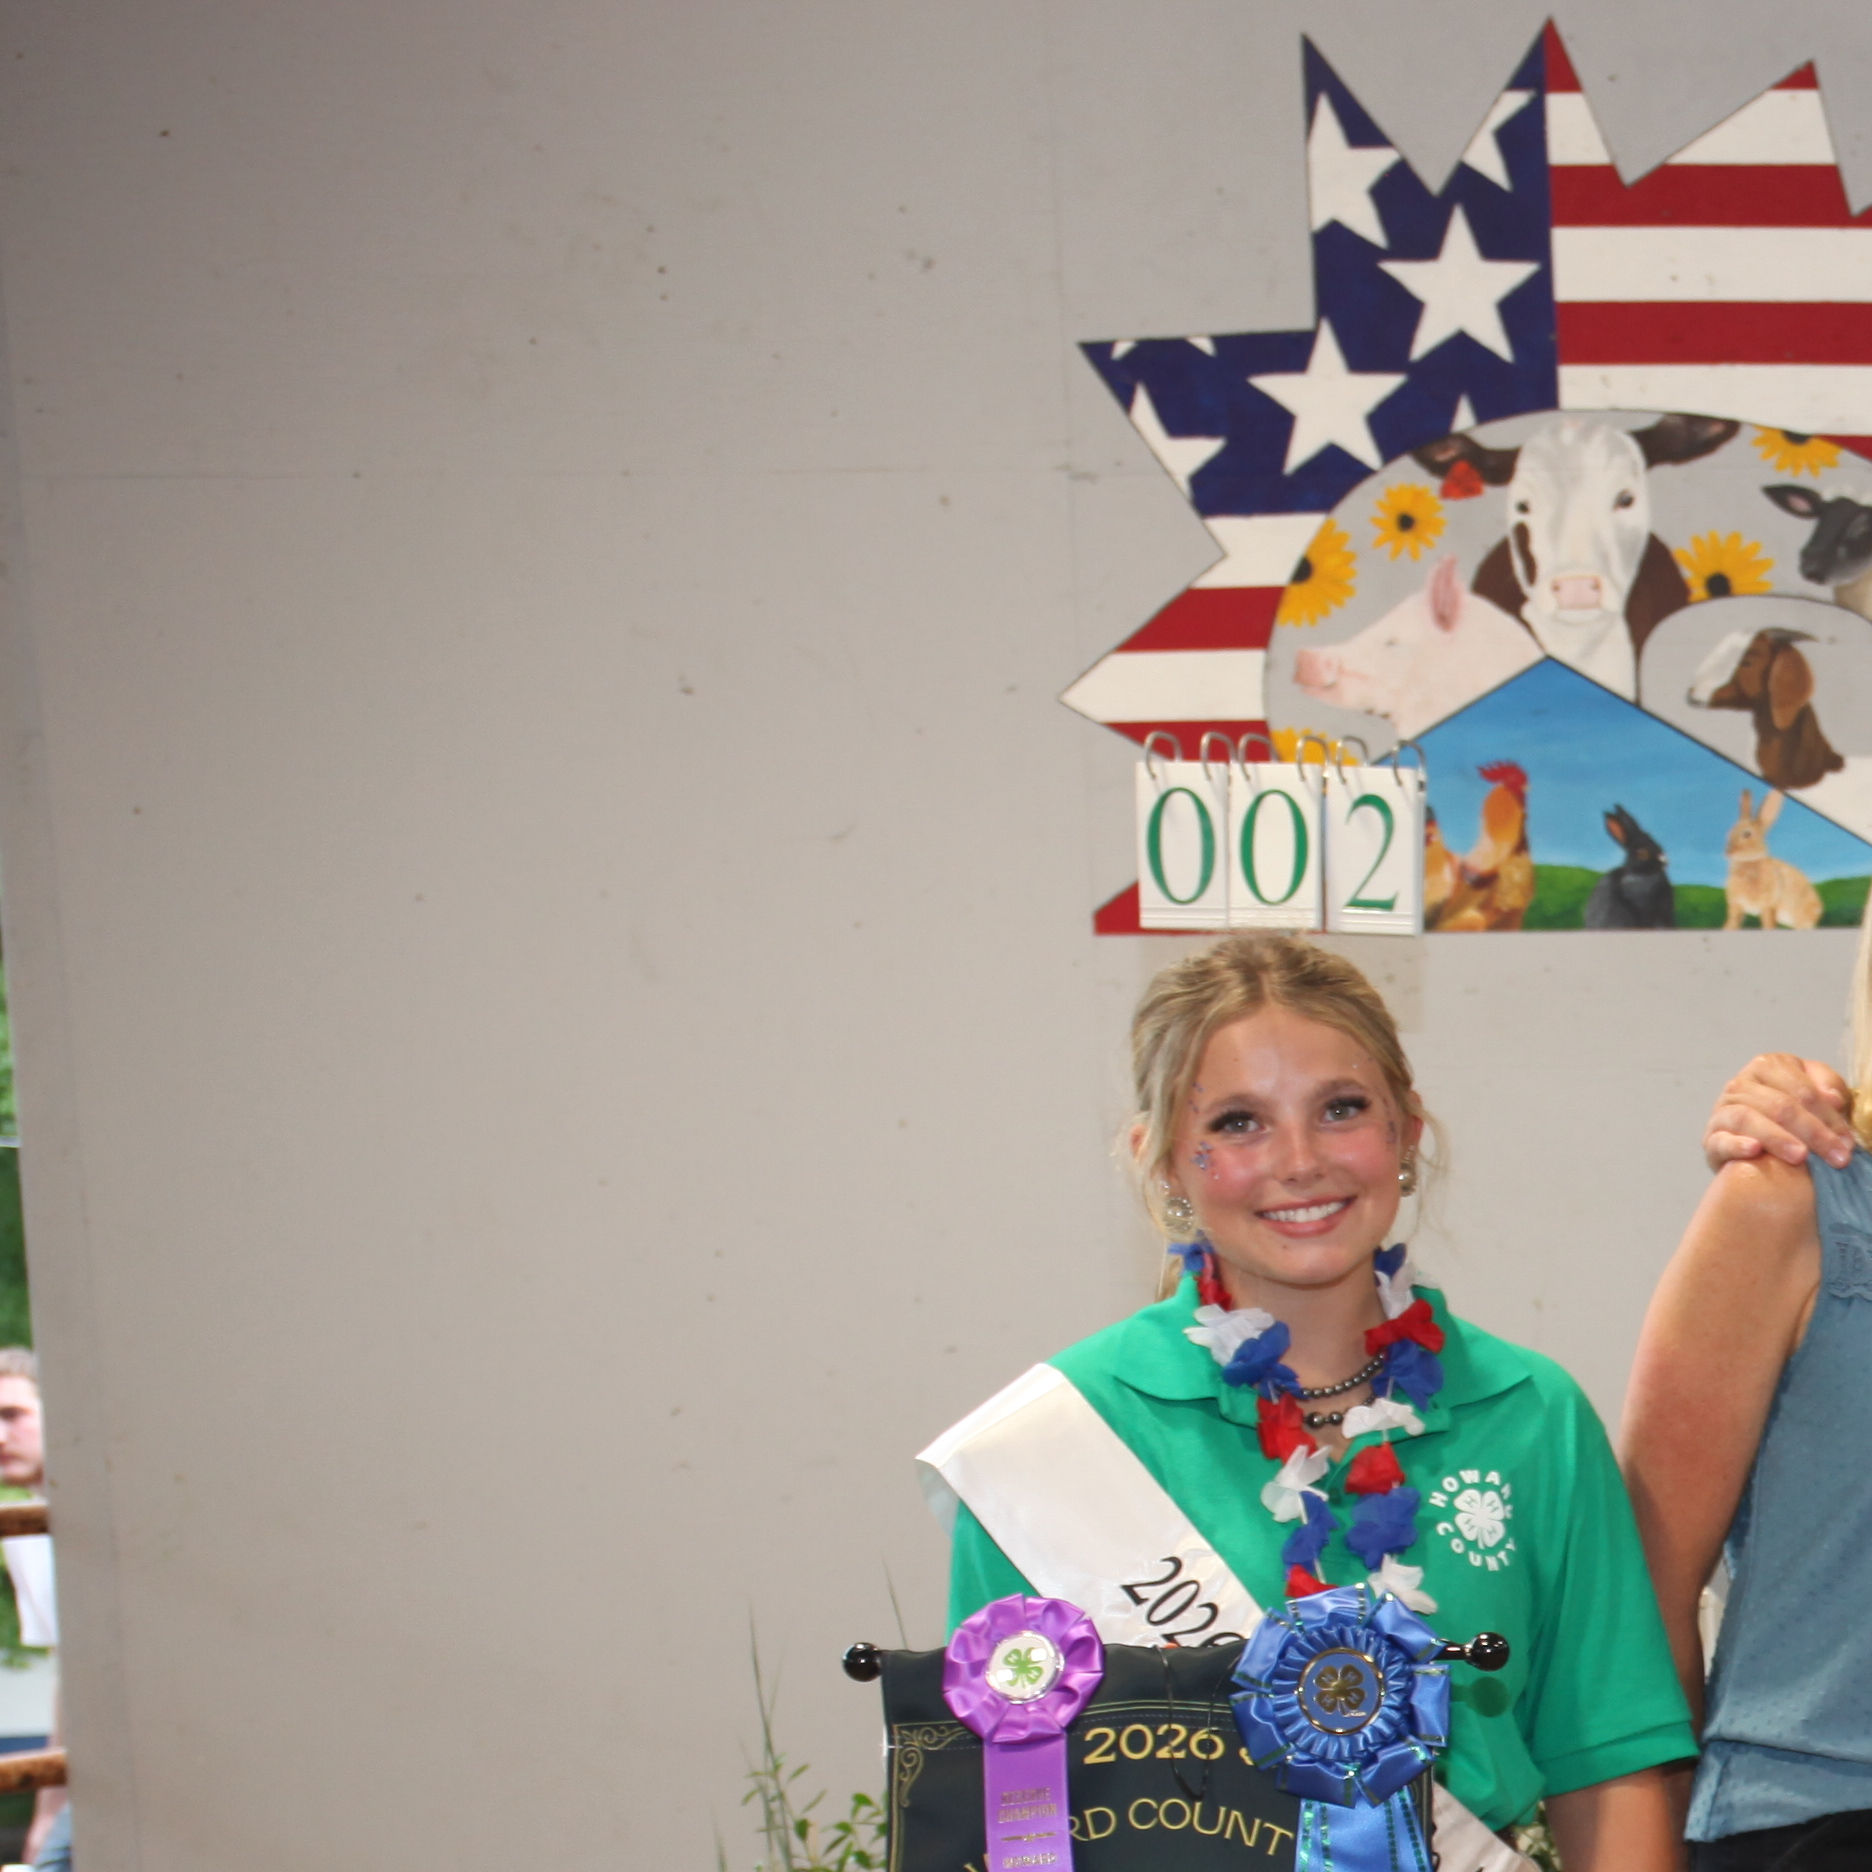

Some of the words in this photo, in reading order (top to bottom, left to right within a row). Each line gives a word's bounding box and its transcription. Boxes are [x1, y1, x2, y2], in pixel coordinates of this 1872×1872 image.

[1146, 786, 1398, 912] 002
[1119, 1555, 1246, 1648] 202
[1083, 1723, 1226, 1766] 2026
[1127, 1797, 1295, 1857] COUNT
